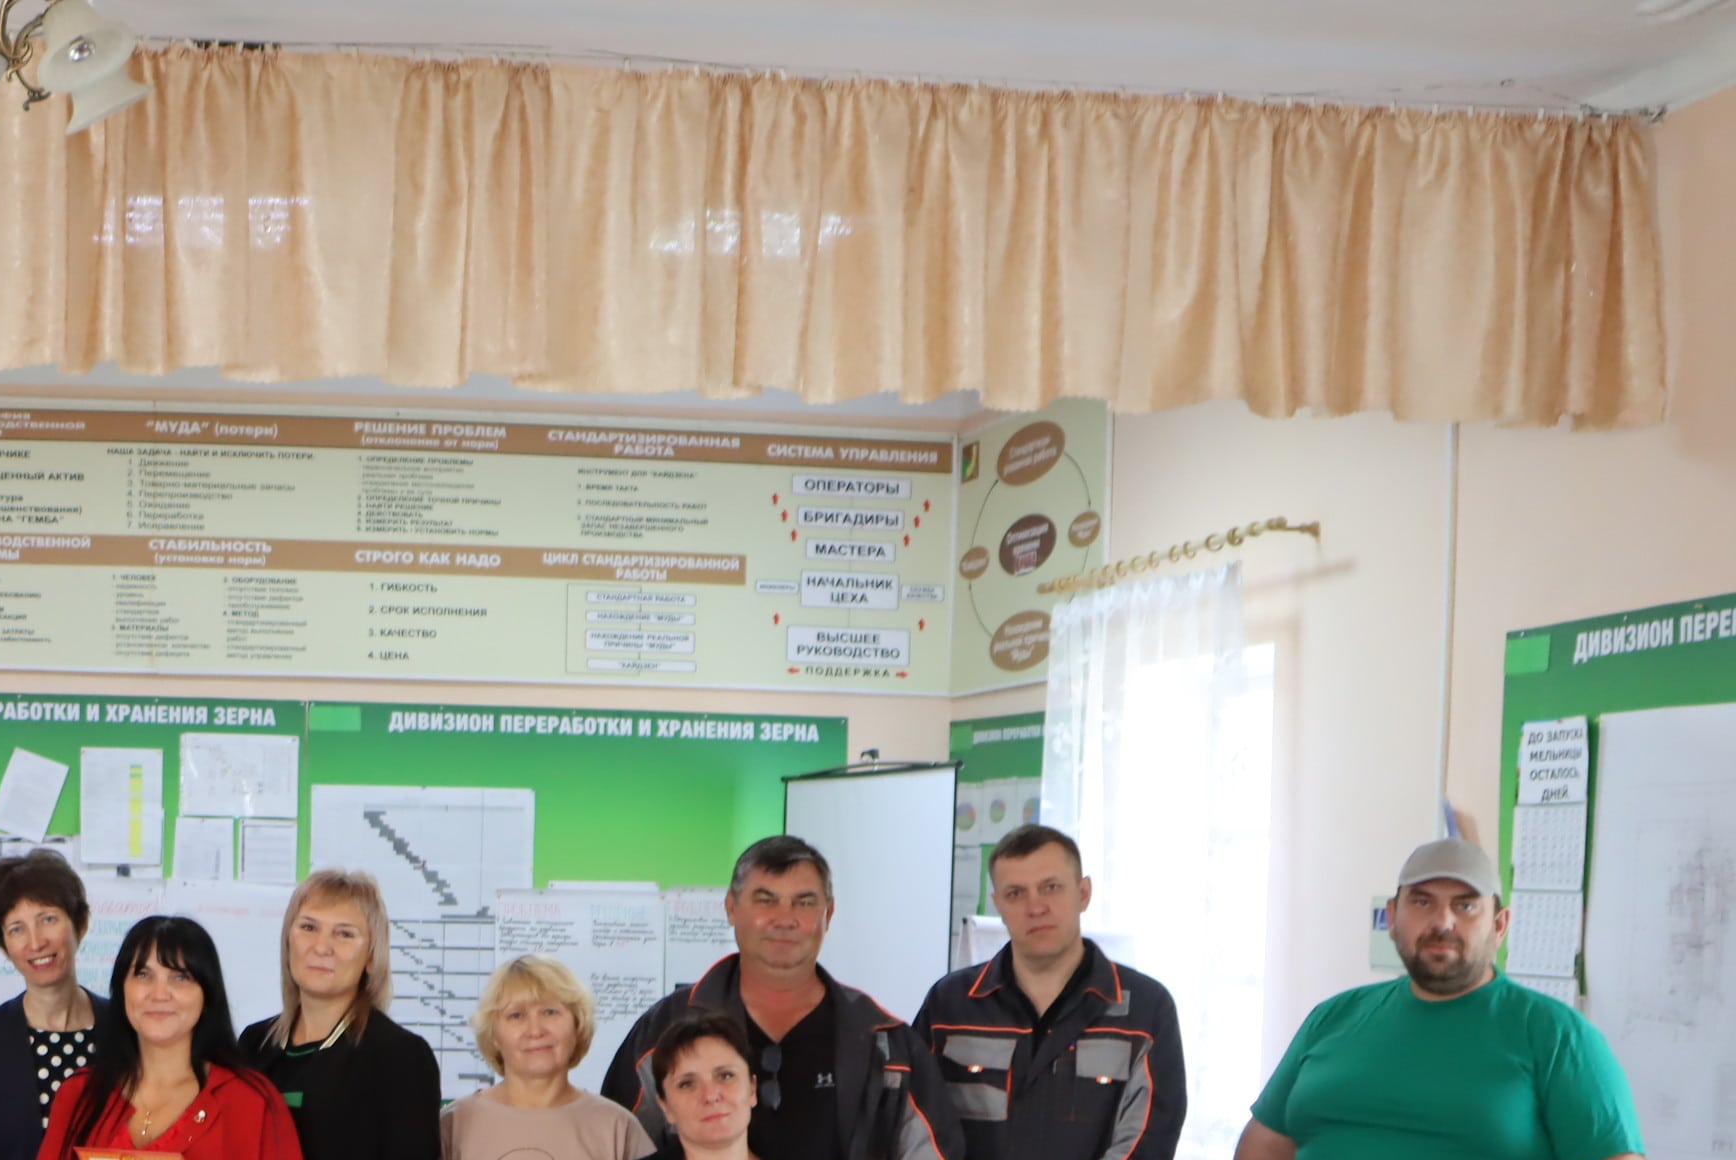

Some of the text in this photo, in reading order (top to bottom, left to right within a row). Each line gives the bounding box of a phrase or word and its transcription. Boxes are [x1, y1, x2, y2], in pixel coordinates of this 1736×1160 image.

[146, 420, 279, 439] "МУДА" (потери)
[354, 422, 506, 438] РЕШЕНИЕ ПРОБЛЕМ
[444, 439, 457, 448] от
[462, 439, 499, 450] норм)
[547, 430, 740, 448] СТАНДАРТИЗИРОВАННАЯ
[614, 445, 674, 457] РАБОТА
[768, 444, 938, 463] СИСТЕМА УПРАВЛЕНИЯ
[48, 472, 85, 481] АКТИВ
[804, 479, 900, 494] ОПЕРАТОРЫ
[803, 511, 899, 526] БРИГАДИРЫ
[148, 539, 272, 554] СТАБИЛЬНОСТЬ
[815, 543, 886, 556] МАСТЕРА
[155, 553, 266, 566] (установка норм)
[355, 550, 501, 568] СТРОГО КАК НАДО
[543, 552, 739, 571] ЦИКЛ СТАНДАРТИЗИРОВАННОЙ
[616, 568, 668, 581] РАБОТЫ
[369, 583, 438, 593] 1. ГИБКОСТЬ
[807, 576, 893, 589] НАЧАЛЬНИК
[830, 591, 868, 603] ЦЕХА
[369, 605, 487, 617] 2. СРОК ИСПОЛНЕНИЯ
[369, 628, 437, 638] 3. КАЧЕСТВО
[816, 632, 881, 645] ВЫСШЕЕ
[1572, 607, 1736, 665] ДИВИЗИОН ПЕРЕ
[368, 651, 409, 661] 4. ЦЕНА
[797, 645, 900, 659] РУКОВОДСТВО
[805, 666, 890, 678] ПОДДЕРЖКА
[85, 704, 100, 722] И
[105, 704, 208, 725] ХРАНЕНИЯ
[213, 707, 276, 726] ЗЕРНА
[388, 712, 820, 742] ДИВИЗИОН ПЕРЕРАБОТКИ И ХРАНЕНИЯ ЗЕРНА
[1528, 732, 1543, 746] ДО
[1530, 767, 1580, 780] ОСТАЛОСЬ
[1541, 785, 1569, 804] ДНЕЙ
